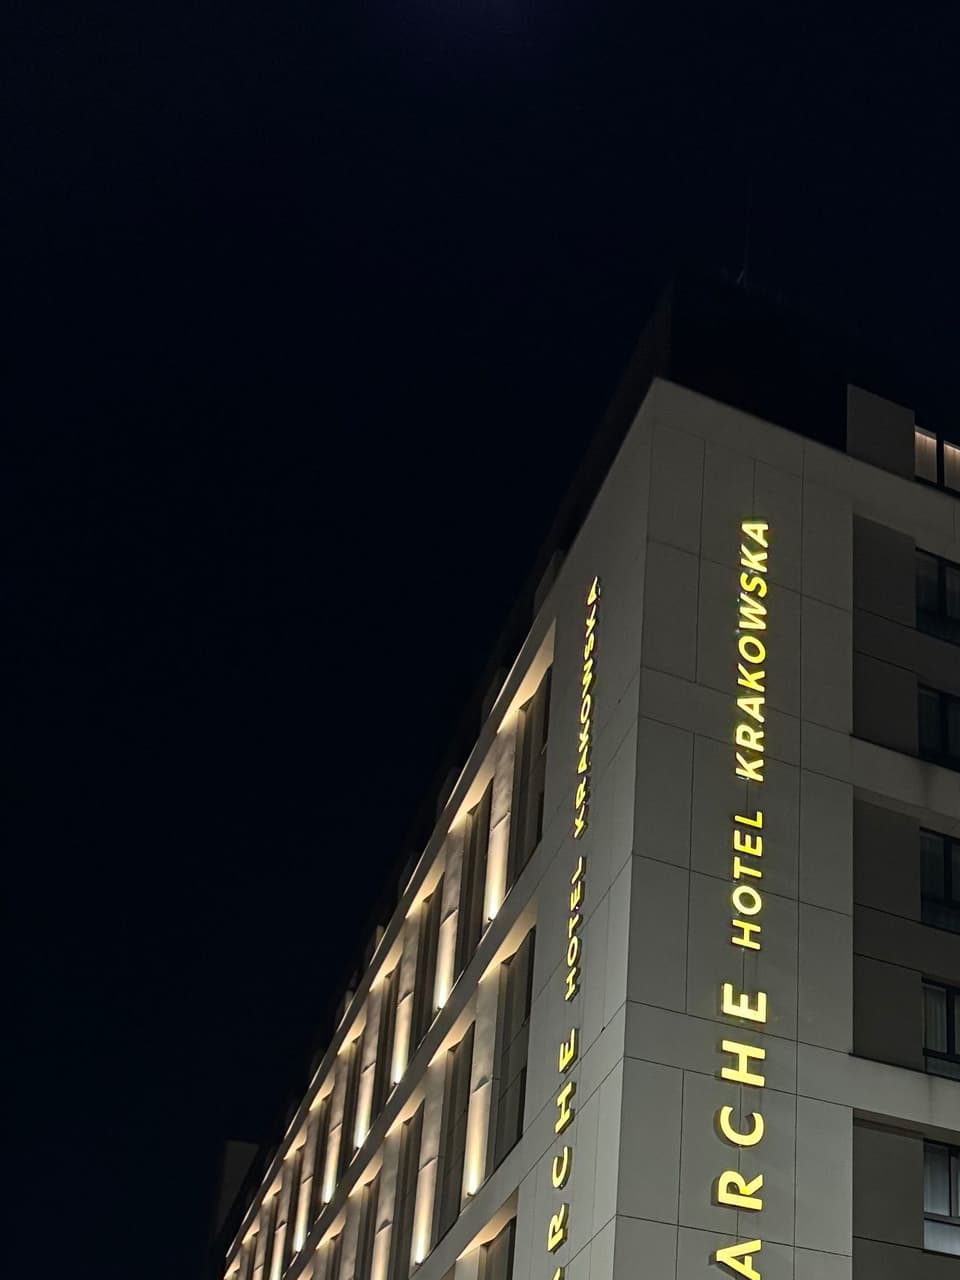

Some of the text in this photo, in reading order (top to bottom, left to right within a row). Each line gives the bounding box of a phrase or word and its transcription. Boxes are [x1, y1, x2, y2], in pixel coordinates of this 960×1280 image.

[573, 576, 599, 839] KRAKOWSKA
[734, 520, 768, 782] KRAKOWSKA
[564, 856, 586, 1001] HOTEL
[732, 810, 764, 950] HOTEL
